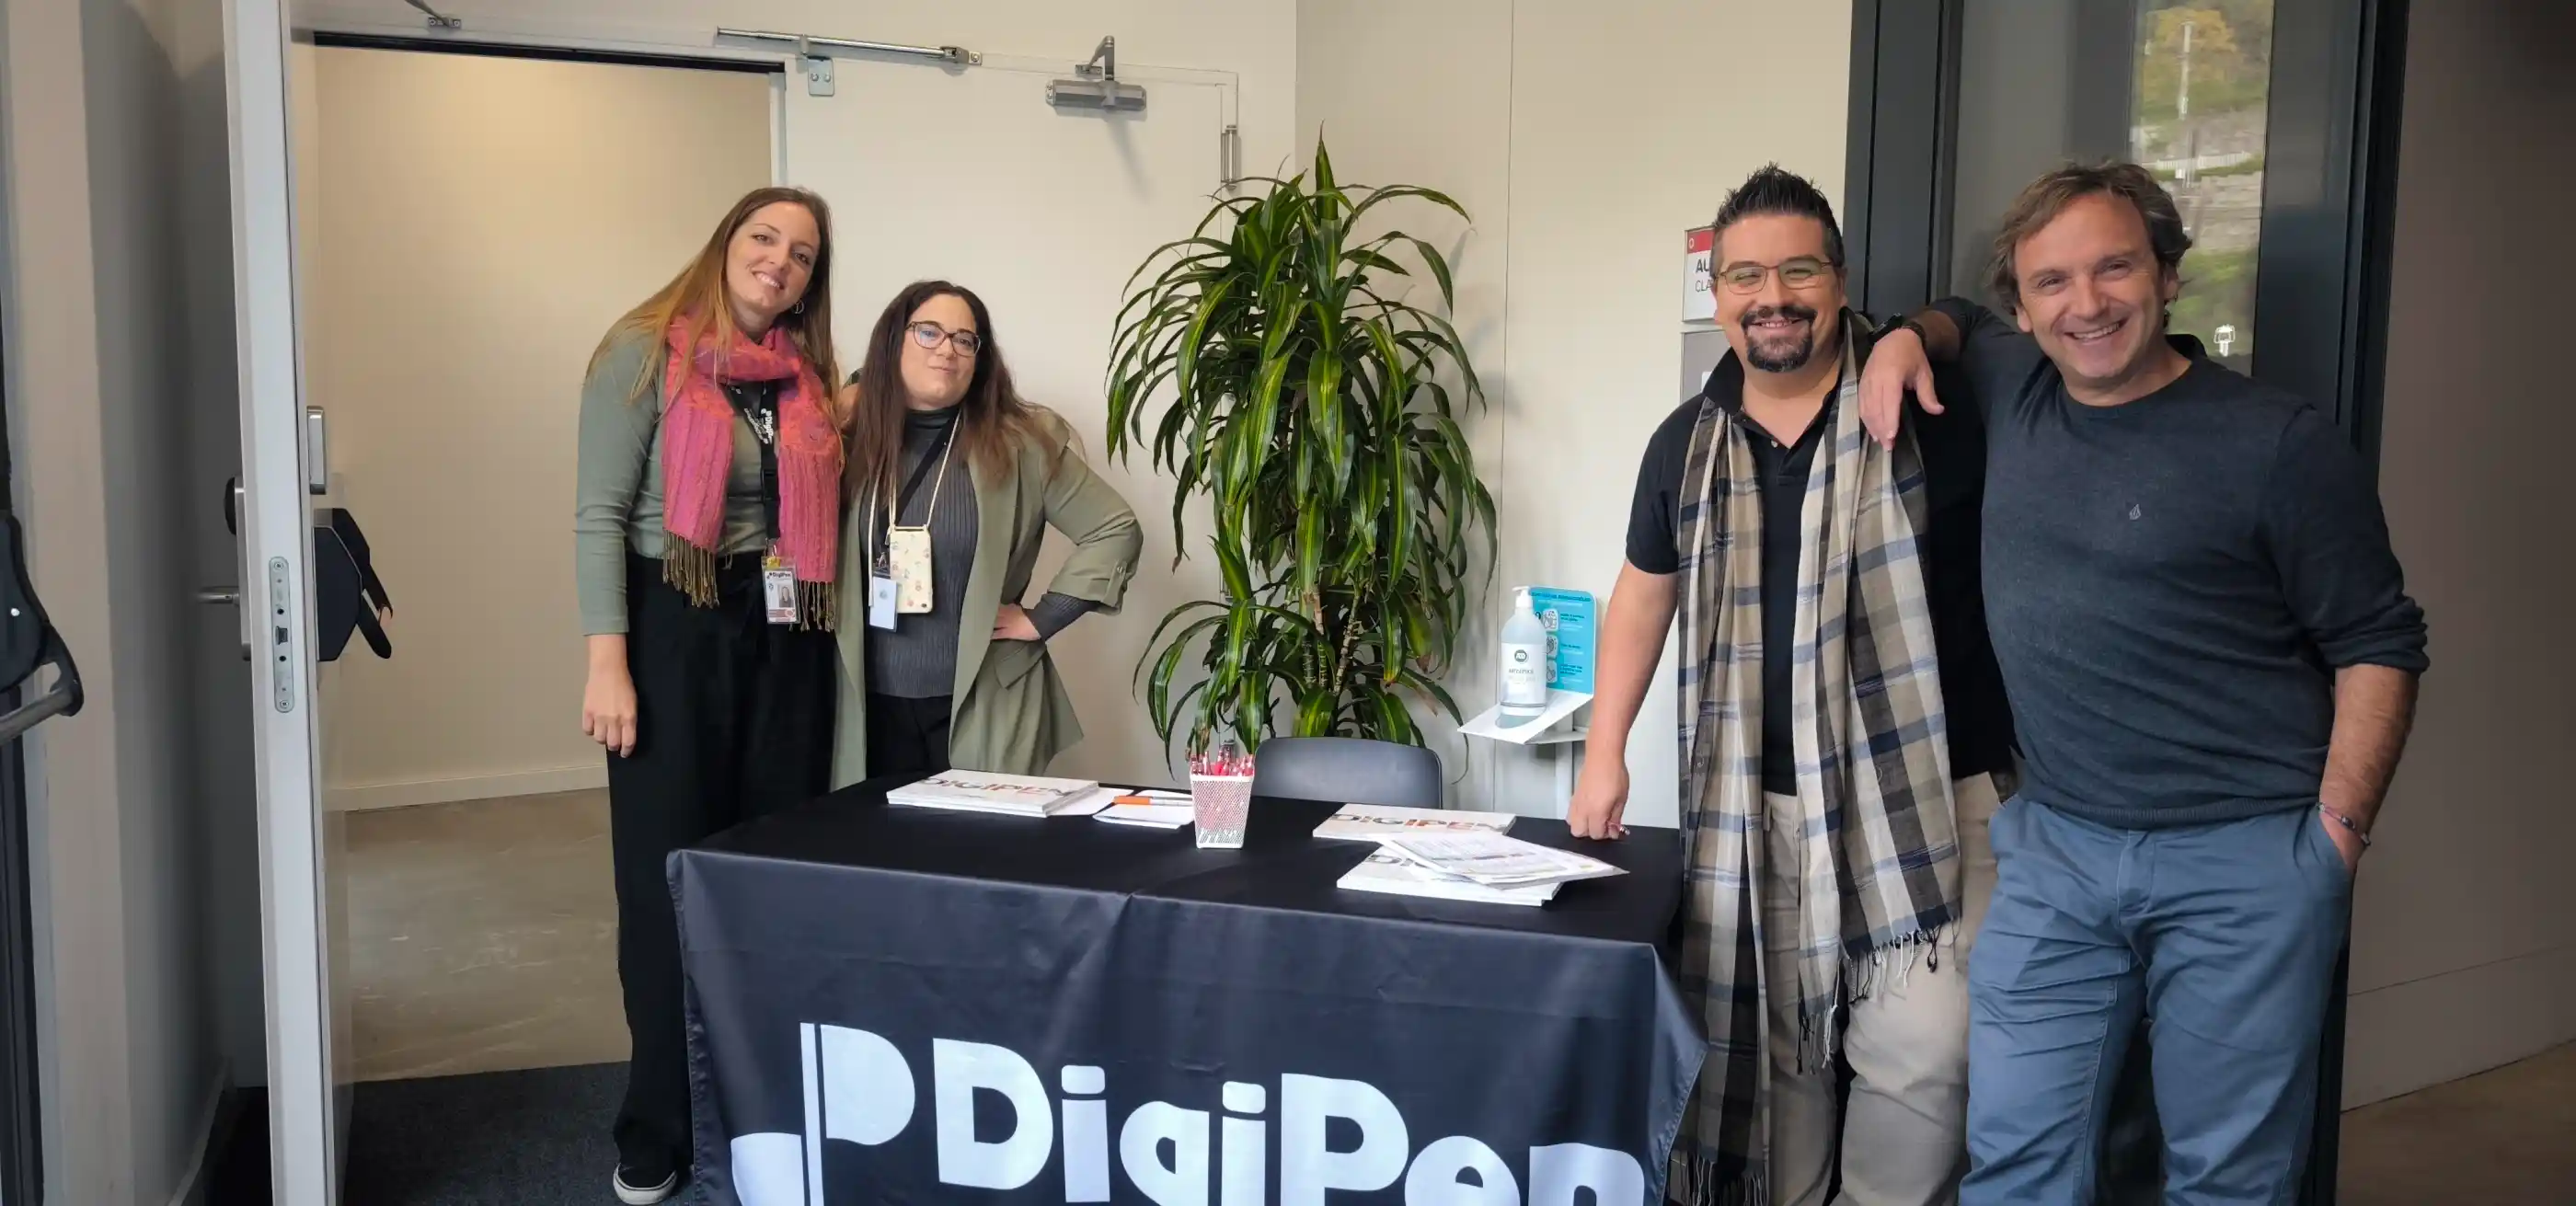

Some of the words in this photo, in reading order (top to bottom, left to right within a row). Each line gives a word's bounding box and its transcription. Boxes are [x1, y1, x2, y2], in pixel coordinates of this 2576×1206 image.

[1696, 258, 1710, 273] AU
[1696, 280, 1713, 293] CLA
[932, 1037, 1646, 1206] DigiPen
